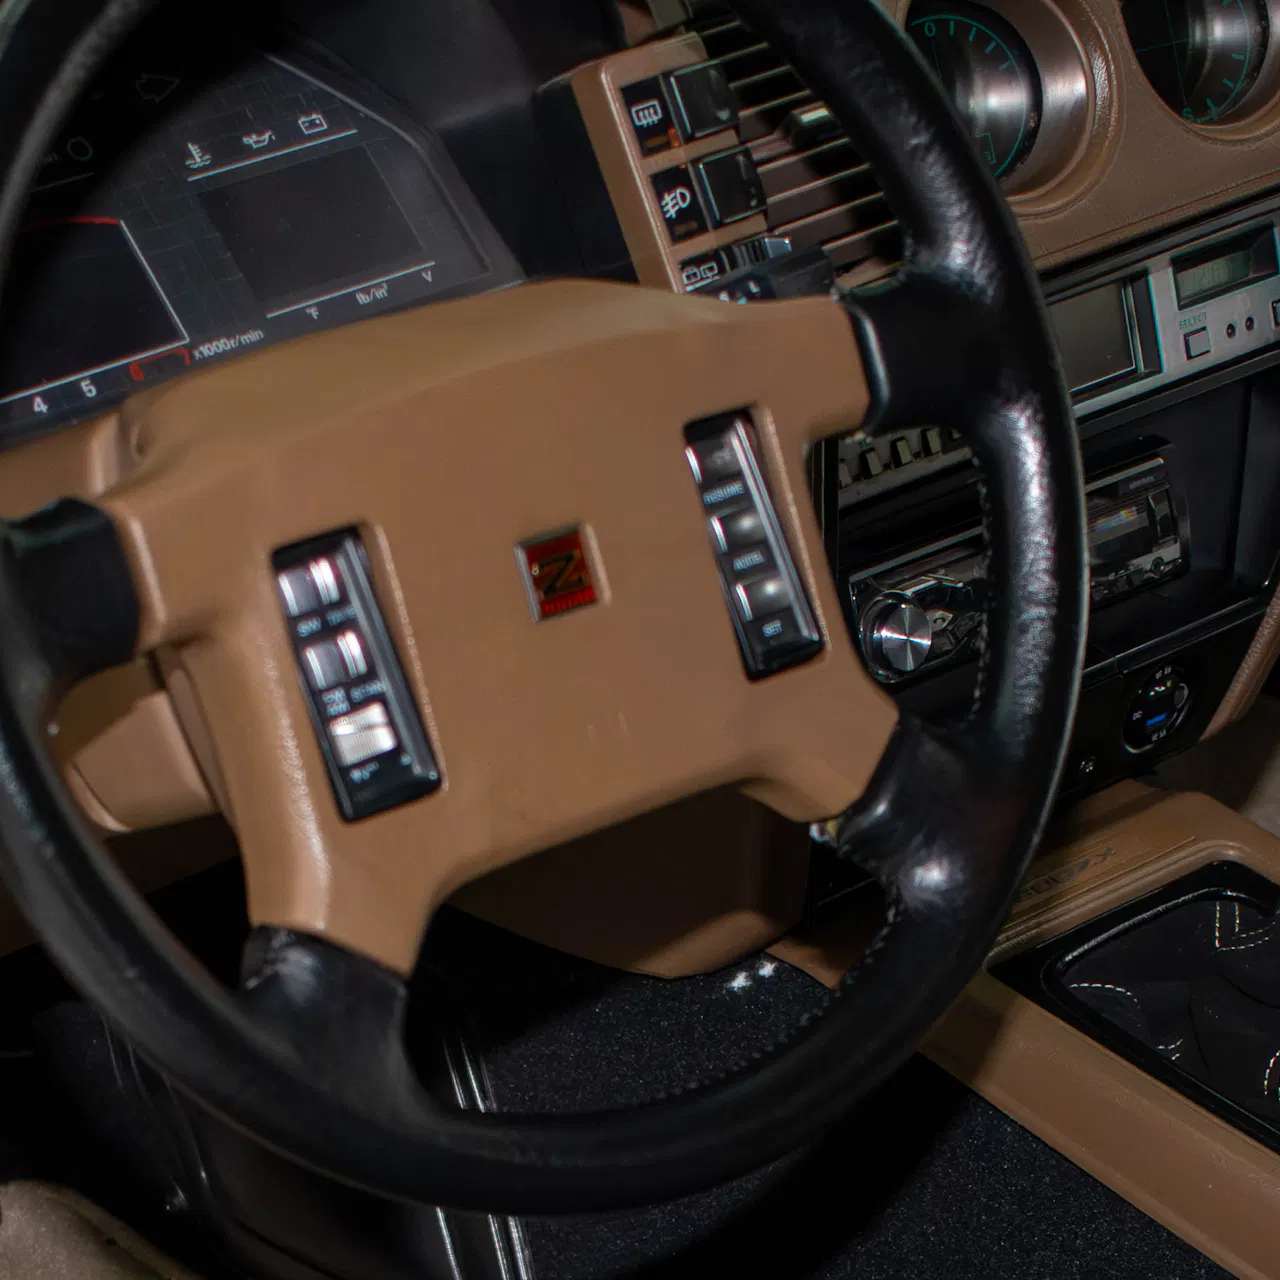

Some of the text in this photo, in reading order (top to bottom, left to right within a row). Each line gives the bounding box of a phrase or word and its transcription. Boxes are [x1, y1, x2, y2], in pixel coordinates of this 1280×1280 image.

[192, 329, 265, 360] x1000r/min
[32, 395, 49, 415] 4
[80, 377, 98, 398] 5
